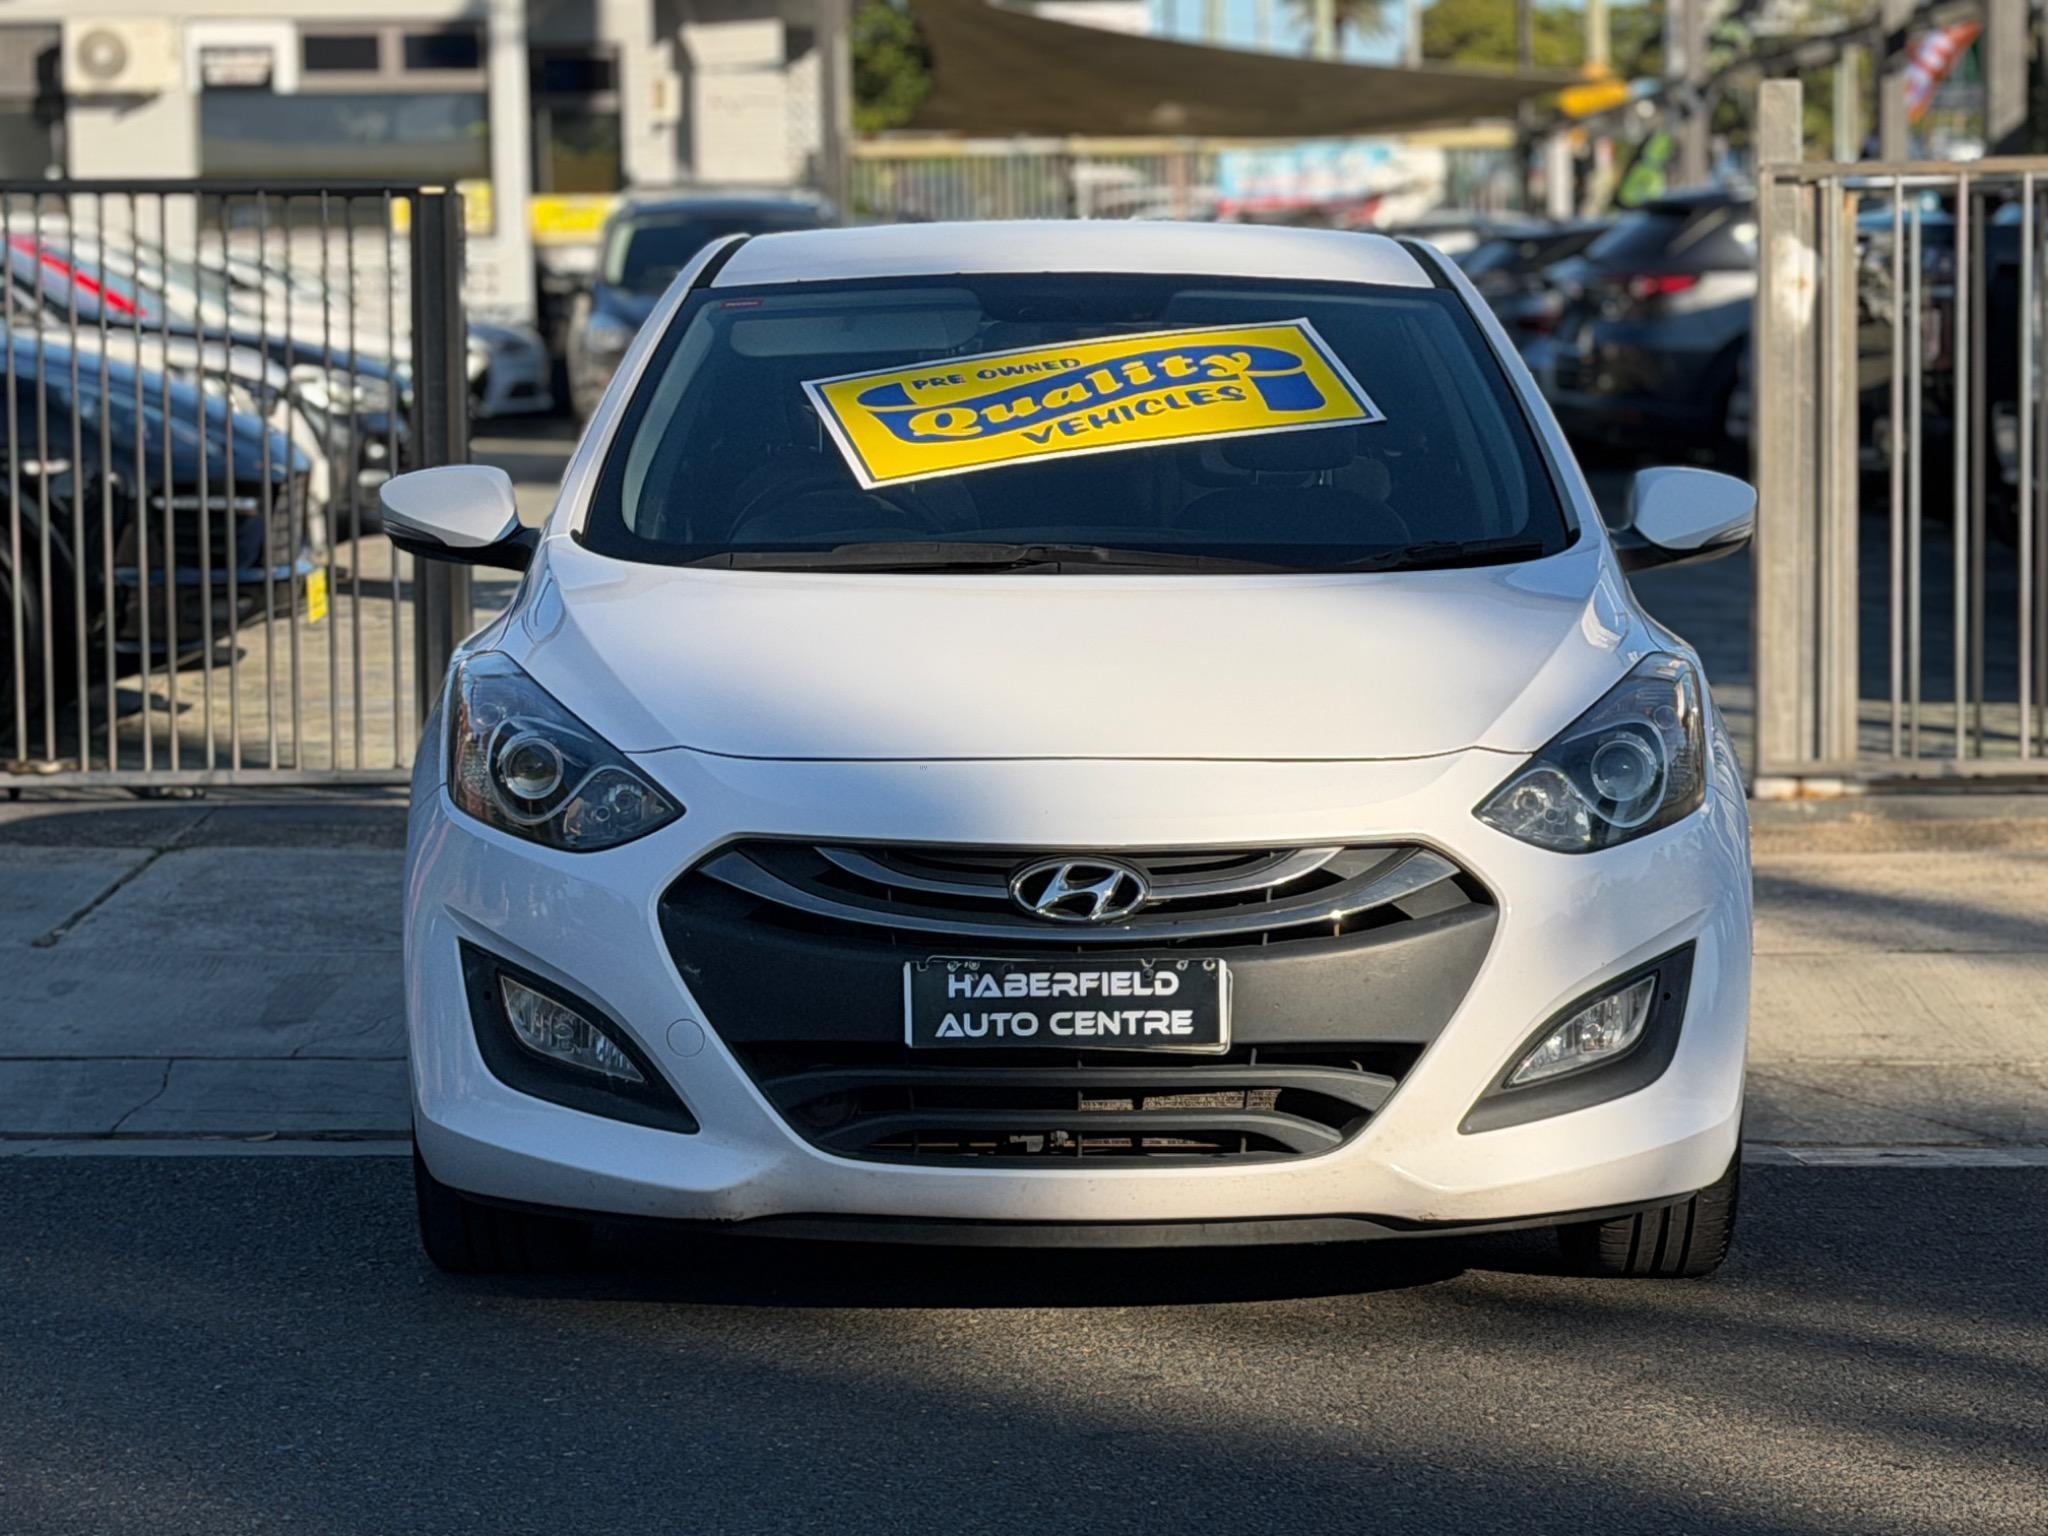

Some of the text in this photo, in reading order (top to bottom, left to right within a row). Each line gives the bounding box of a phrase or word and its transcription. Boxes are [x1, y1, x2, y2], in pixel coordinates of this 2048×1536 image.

[911, 358, 1082, 390] PRE OWNED
[908, 351, 1253, 436] Quality
[1020, 385, 1247, 444] VEHICLES
[948, 971, 1180, 998] HABERFIELD
[934, 1010, 1195, 1037] AUTO CENTRE
